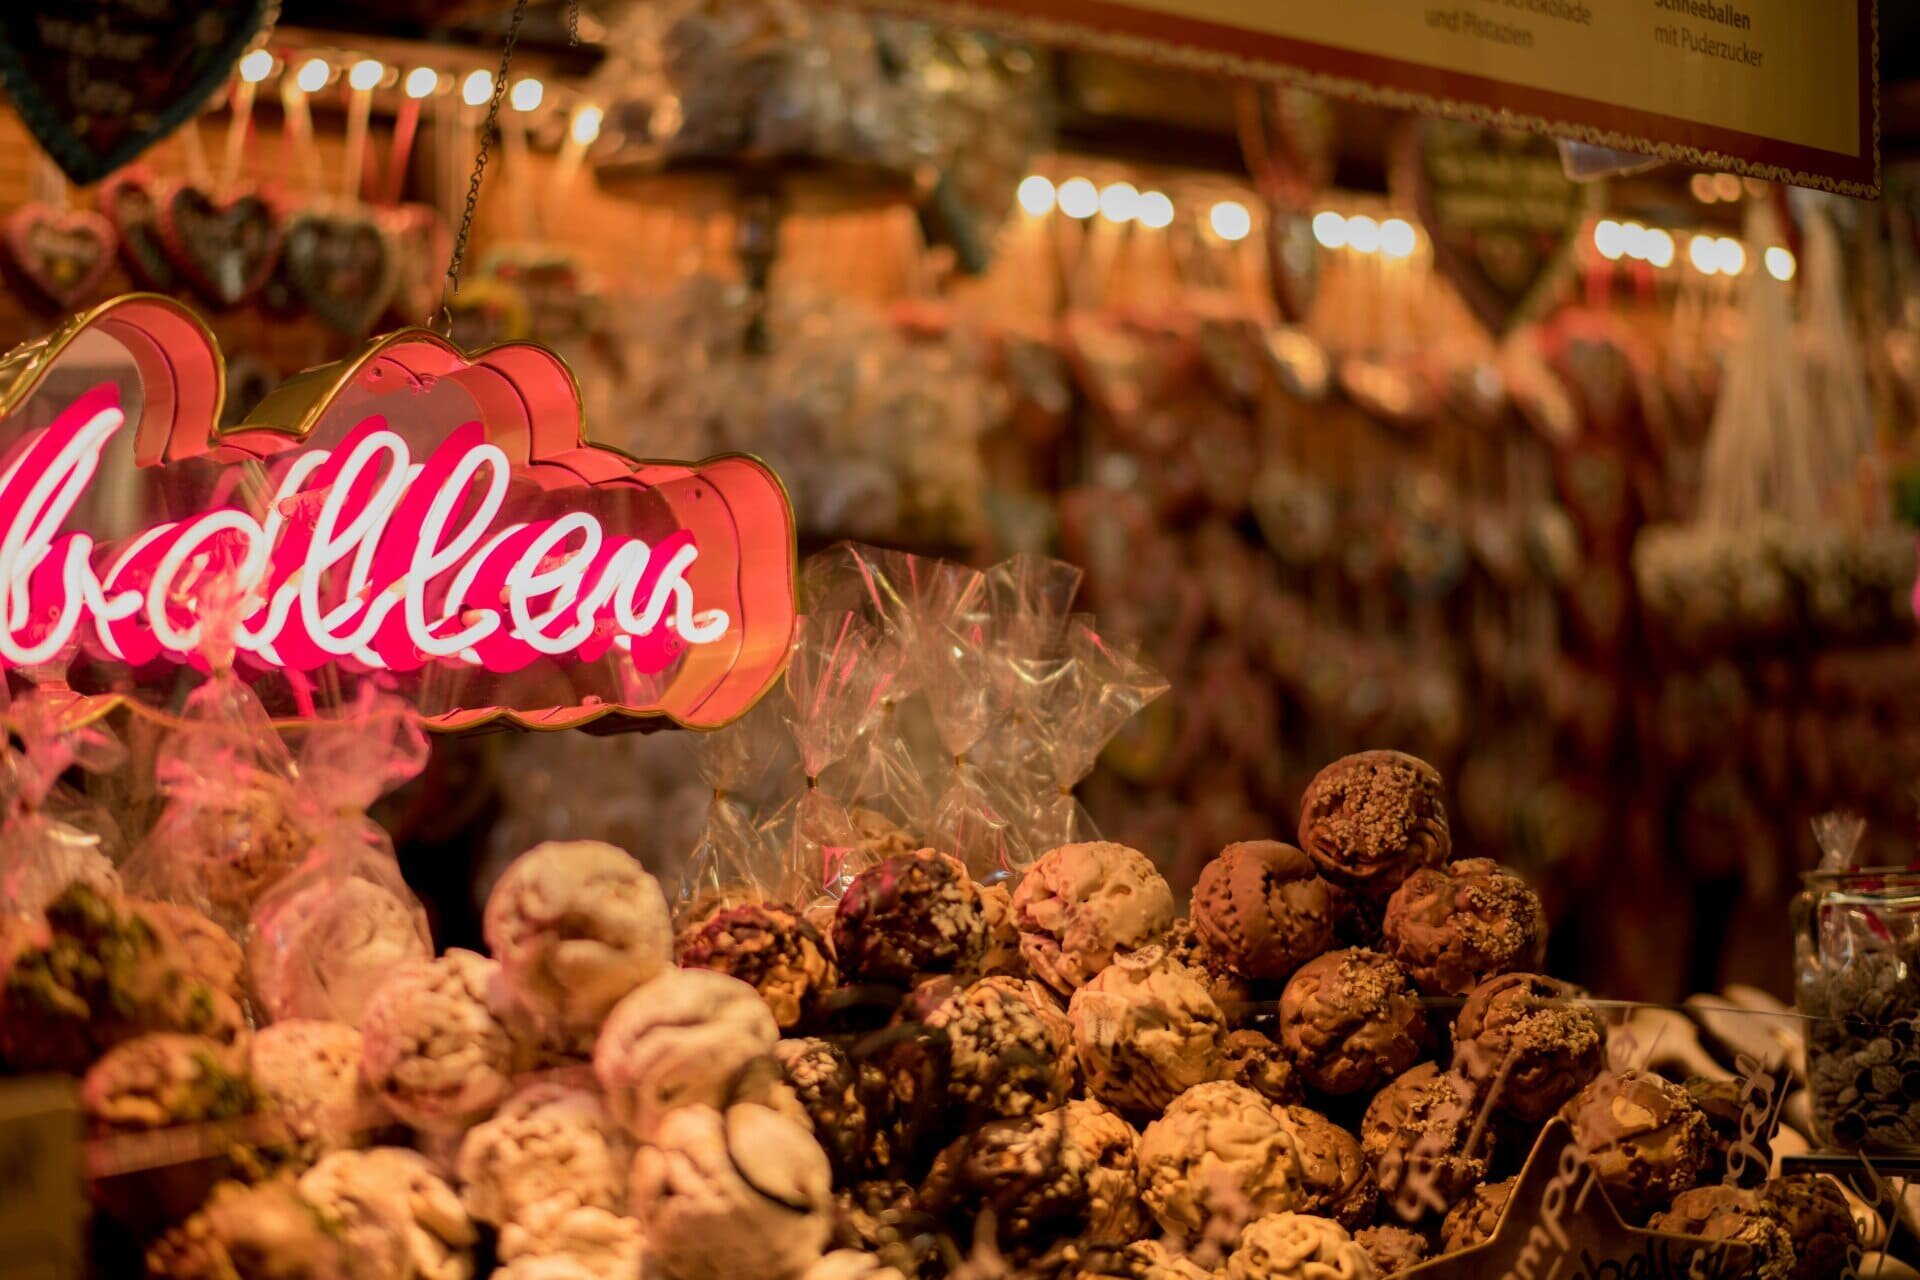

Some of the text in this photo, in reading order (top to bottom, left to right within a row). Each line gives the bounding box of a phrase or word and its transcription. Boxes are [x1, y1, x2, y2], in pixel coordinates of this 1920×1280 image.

[1424, 8, 1458, 33] und
[1655, 24, 1764, 67] mit Puderzucker
